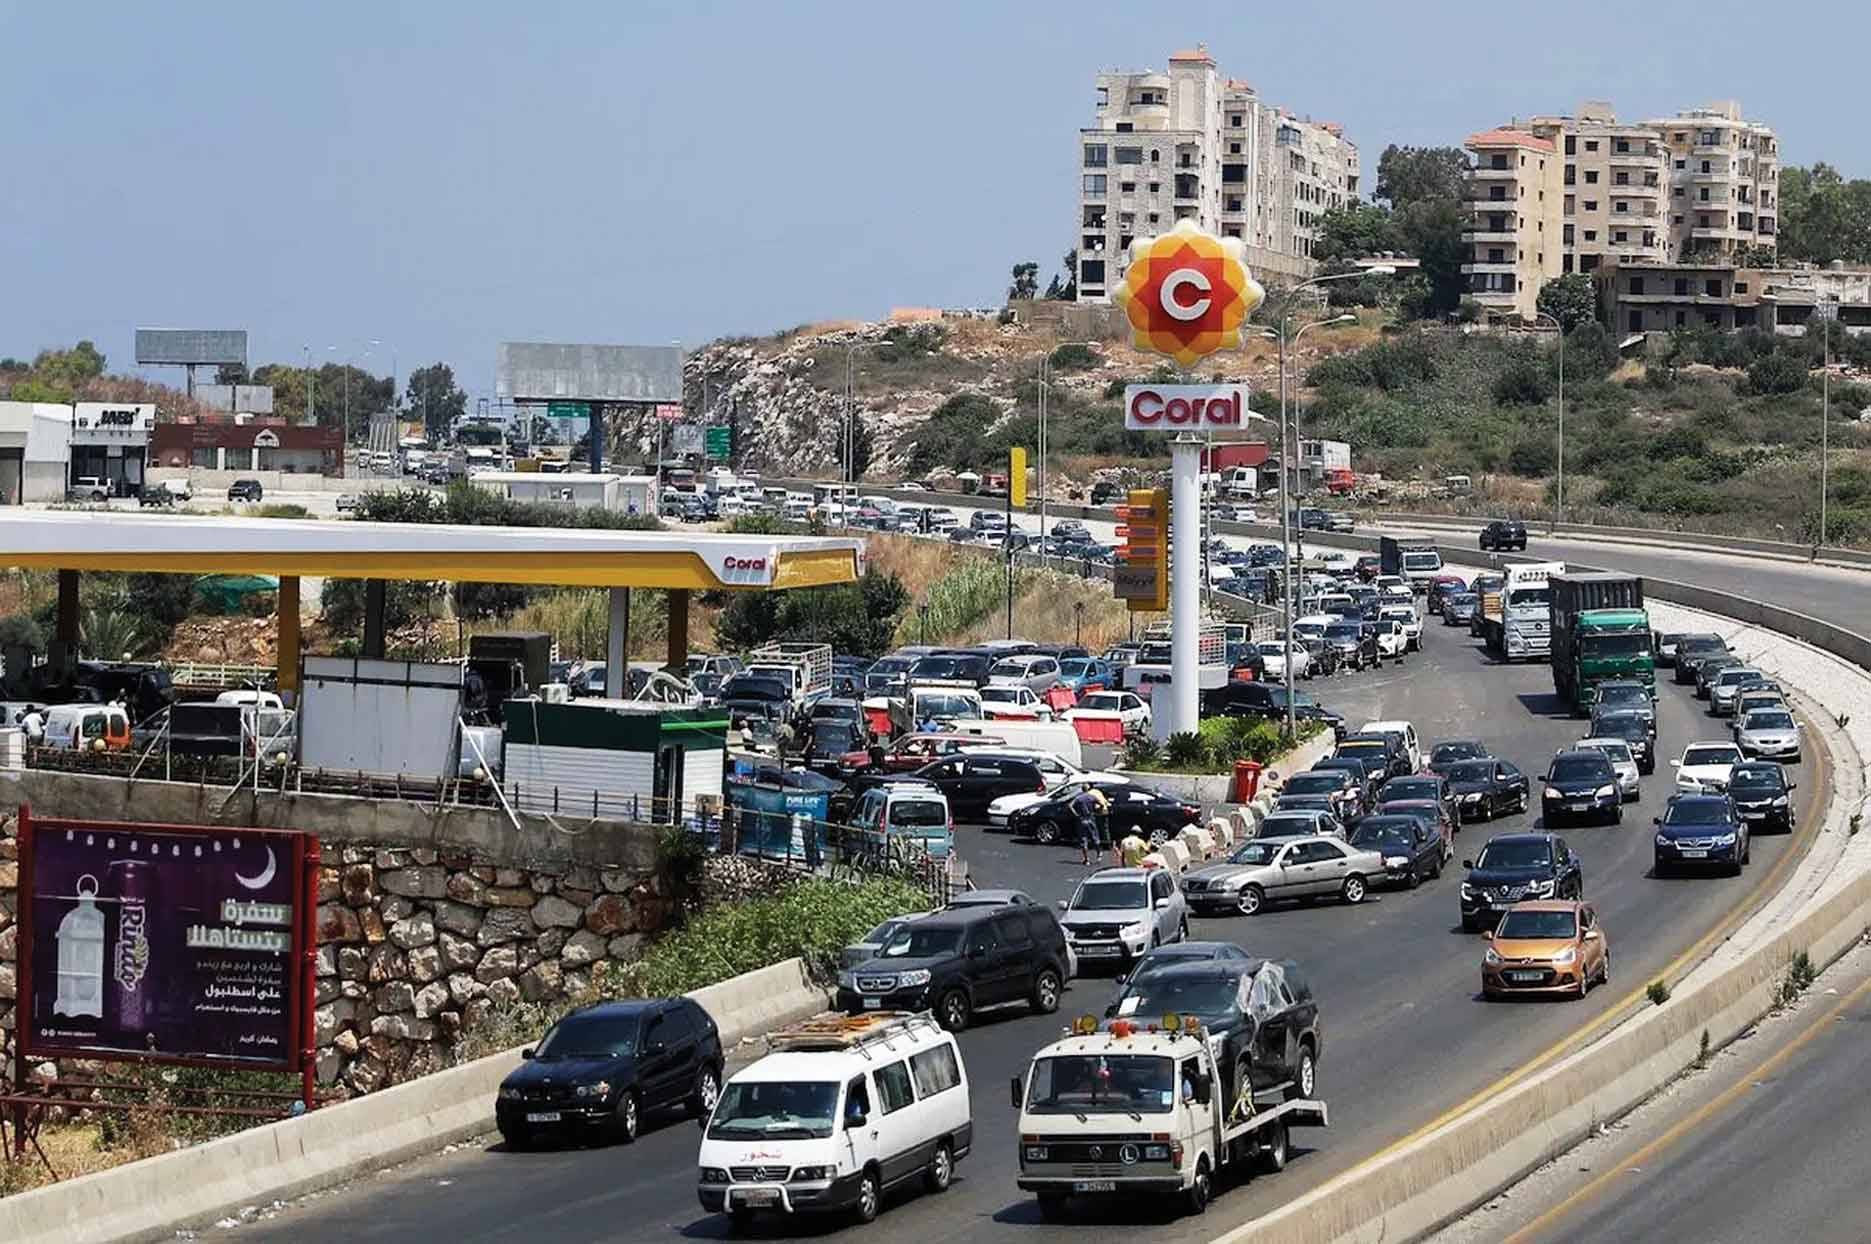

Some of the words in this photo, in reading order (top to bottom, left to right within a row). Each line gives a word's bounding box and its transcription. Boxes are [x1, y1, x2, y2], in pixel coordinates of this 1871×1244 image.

[1160, 268, 1213, 321] C
[1131, 390, 1241, 425] Coral
[723, 556, 766, 571] Coral
[224, 898, 283, 925] سفرة
[257, 986, 281, 1000] على
[1124, 1146, 1135, 1161] L
